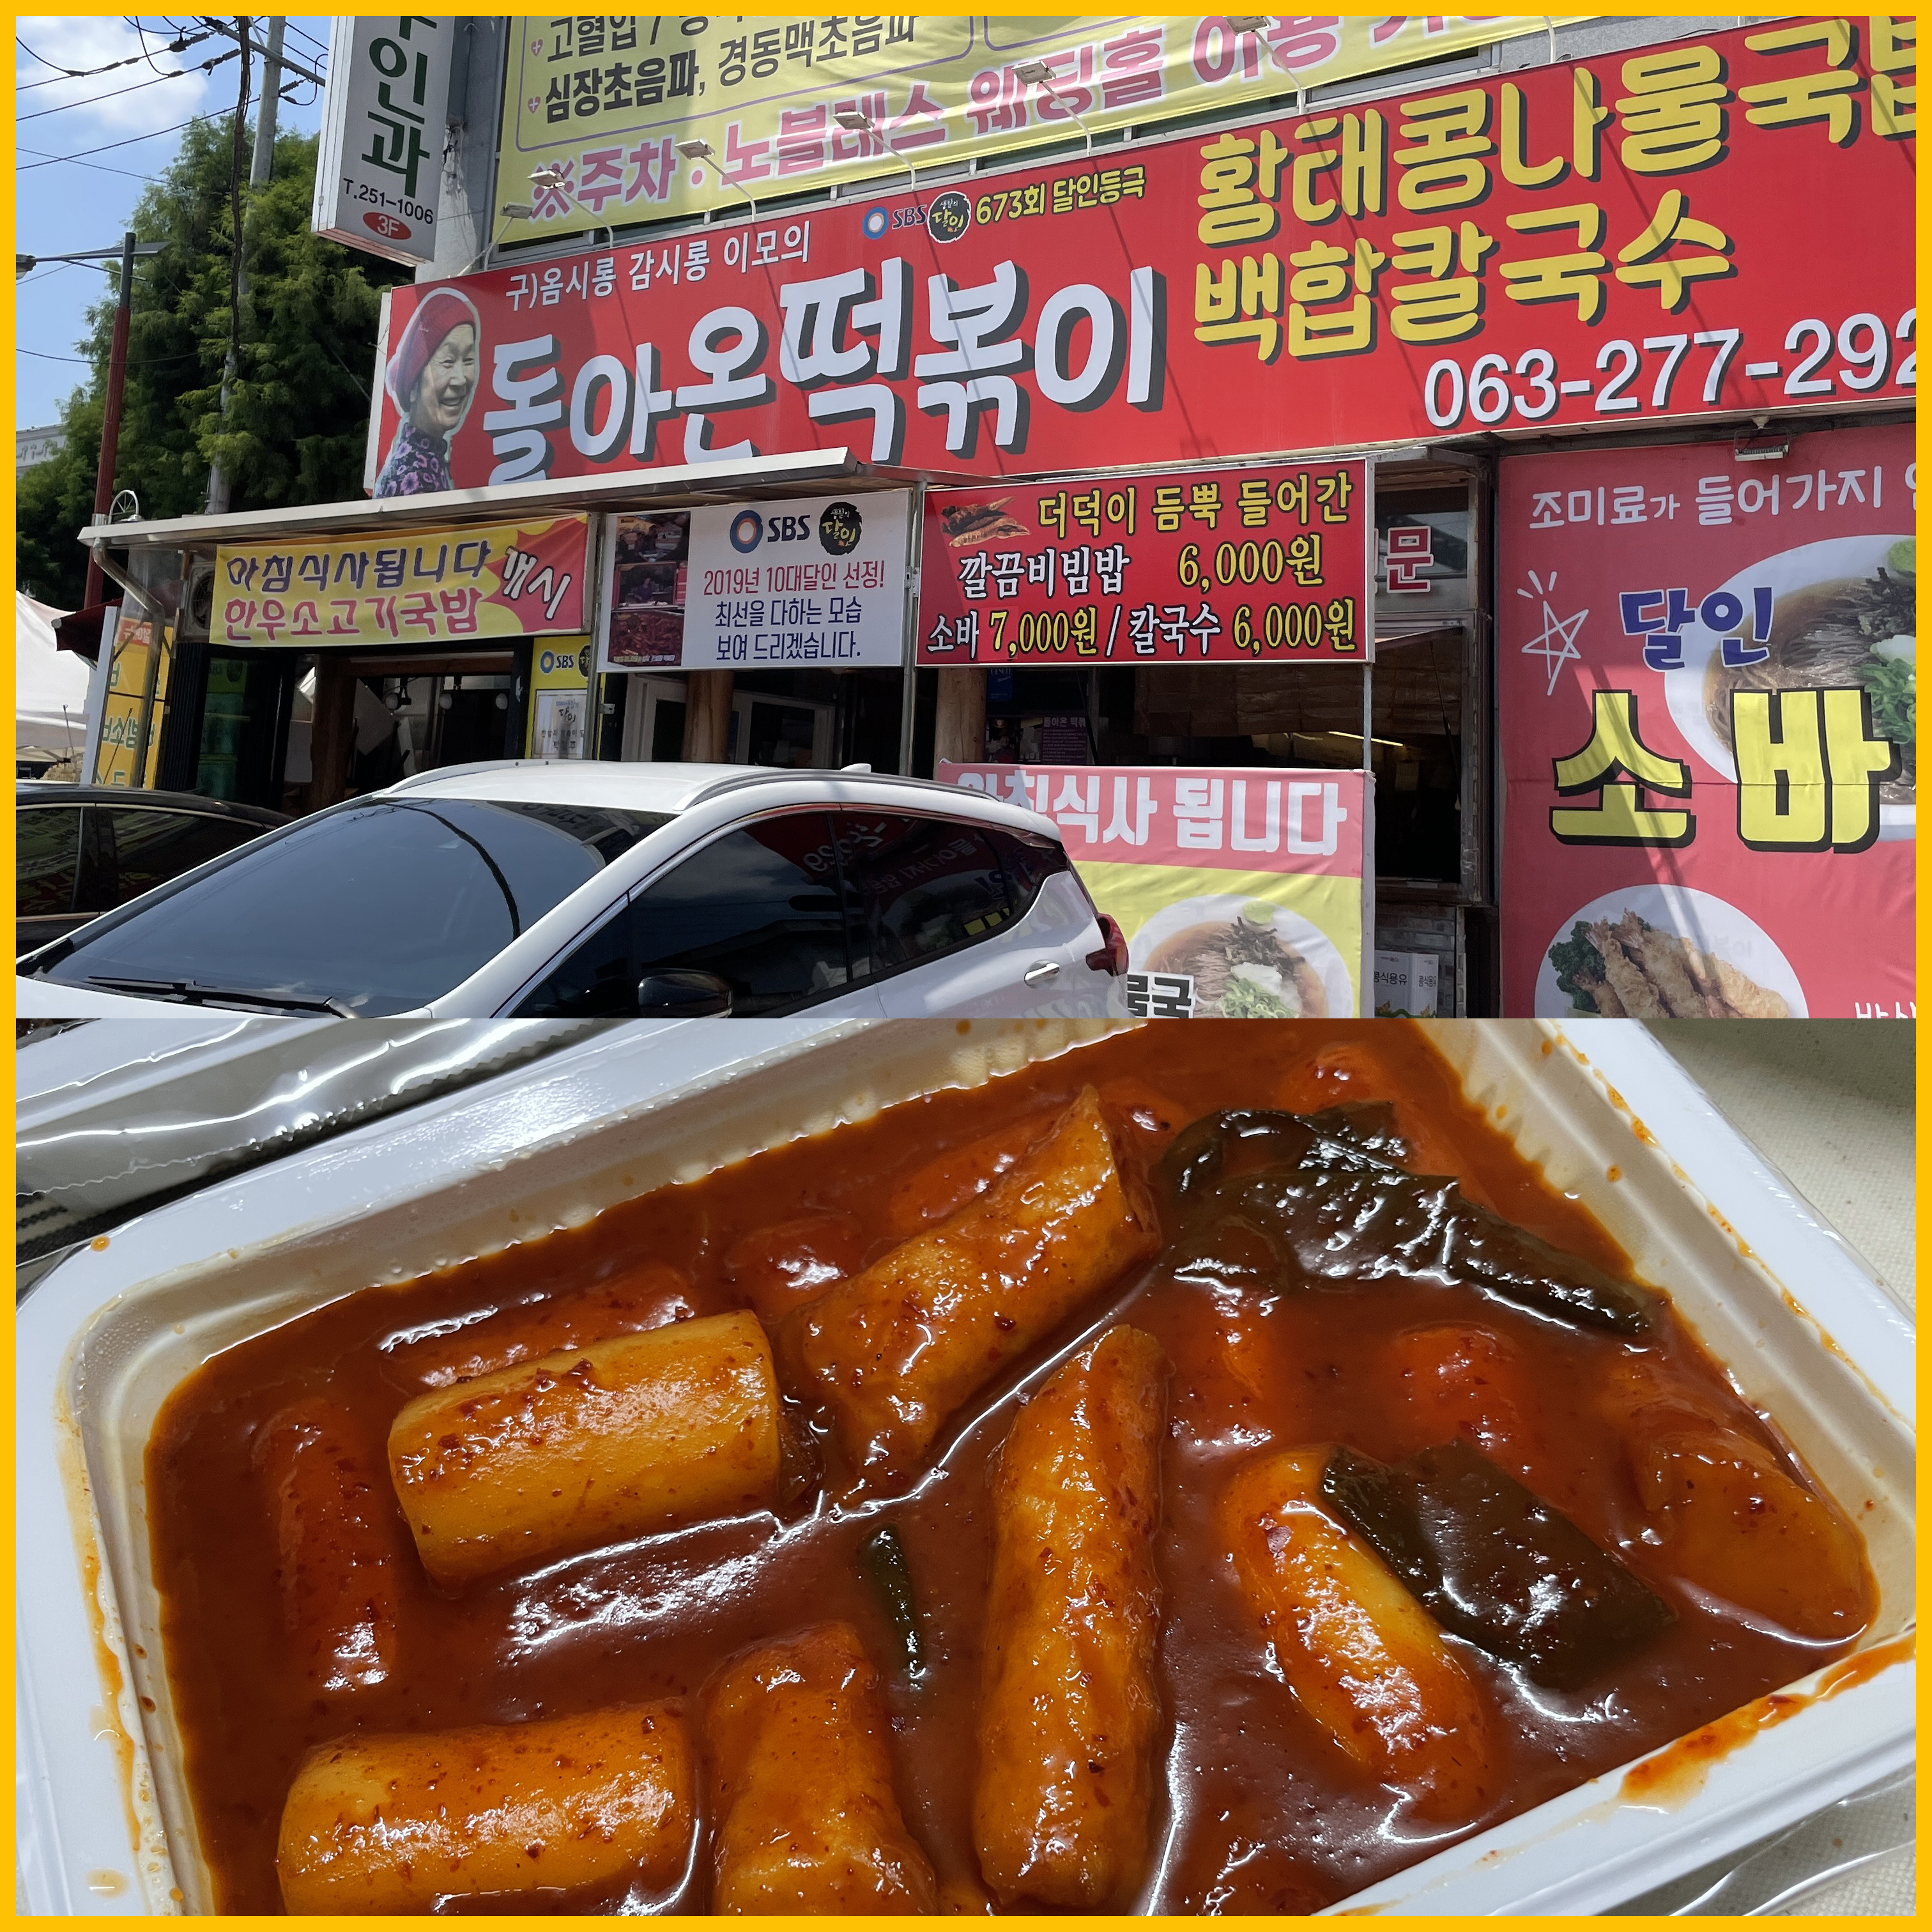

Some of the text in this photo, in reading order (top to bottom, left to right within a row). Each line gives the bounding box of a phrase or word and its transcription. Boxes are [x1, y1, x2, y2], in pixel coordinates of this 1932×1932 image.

[362, 17, 437, 199] 인과
[721, 84, 946, 186] 노블레스
[343, 177, 434, 225] T.251-1006
[376, 215, 400, 237] 3F
[892, 205, 926, 229] SBS
[976, 166, 1146, 225] 673회 달인등극
[505, 220, 811, 311] 구)옴시롱 감시롱 이모의
[1194, 189, 1735, 364] 백합칼국수
[1039, 472, 1352, 538] 더덕이 듬뿍 들어간
[1529, 486, 1681, 529] 조미료가
[1696, 466, 1882, 526] 들어가지
[767, 515, 811, 542] SBS
[822, 519, 856, 547] 달인
[502, 546, 572, 620] 개시
[704, 560, 885, 595] 2019년 10대달인 선정!
[958, 534, 1324, 599] 깔끔비빔밥 6,000원
[1374, 526, 1434, 594] 문
[715, 596, 862, 627] 최선을 다하는 모습
[927, 610, 979, 659] 소바
[990, 606, 1098, 656] 7,000원
[1130, 603, 1221, 656] 칼국수
[1234, 599, 1356, 656] 6,000원
[1618, 586, 1775, 671] 달인
[556, 655, 574, 668] SBS
[716, 631, 861, 661] 보여 드리겠습니다.
[1173, 776, 1347, 855] 됩니다
